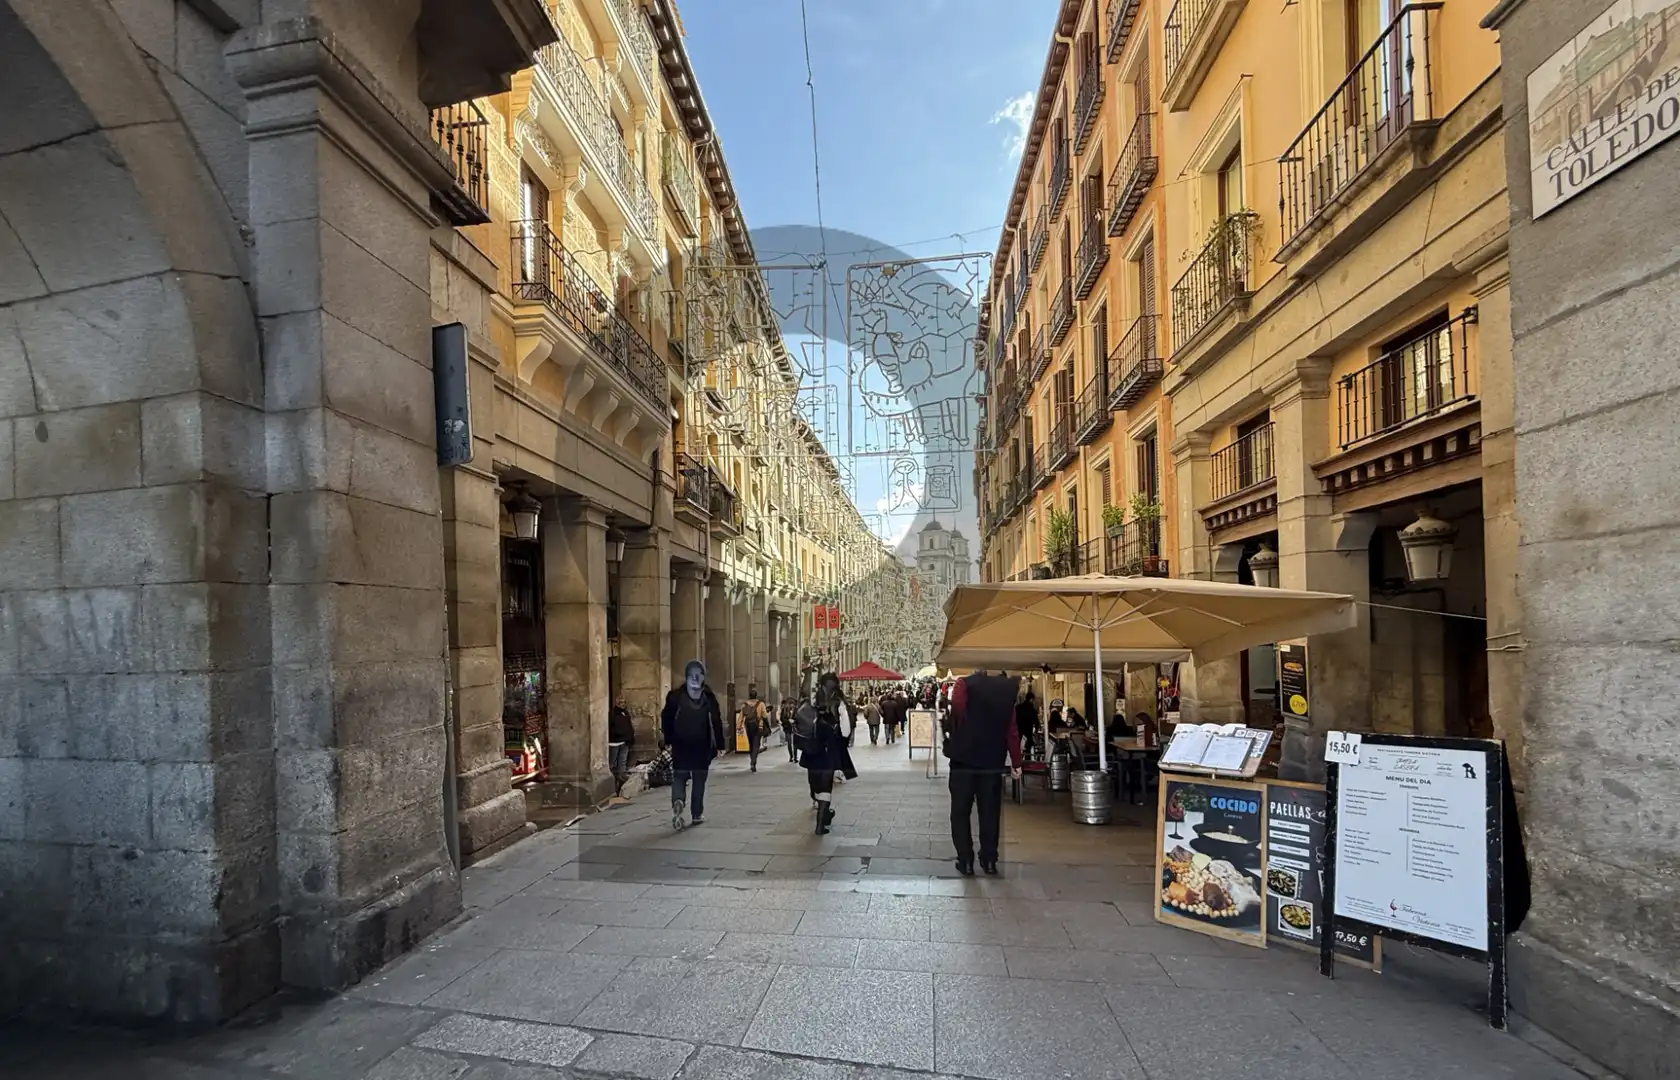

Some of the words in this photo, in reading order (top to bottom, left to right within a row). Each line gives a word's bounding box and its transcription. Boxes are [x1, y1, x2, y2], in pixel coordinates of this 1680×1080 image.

[1547, 96, 1636, 170] CALLE
[1646, 66, 1680, 104] DE
[1549, 97, 1679, 200] TOLEDO
[1329, 741, 1350, 754] 15,50
[1353, 744, 1358, 754] €
[1210, 797, 1257, 814] COCIDO
[1270, 801, 1311, 820] PAELLAS
[1335, 930, 1357, 943] 17,50
[1359, 936, 1368, 946] €
